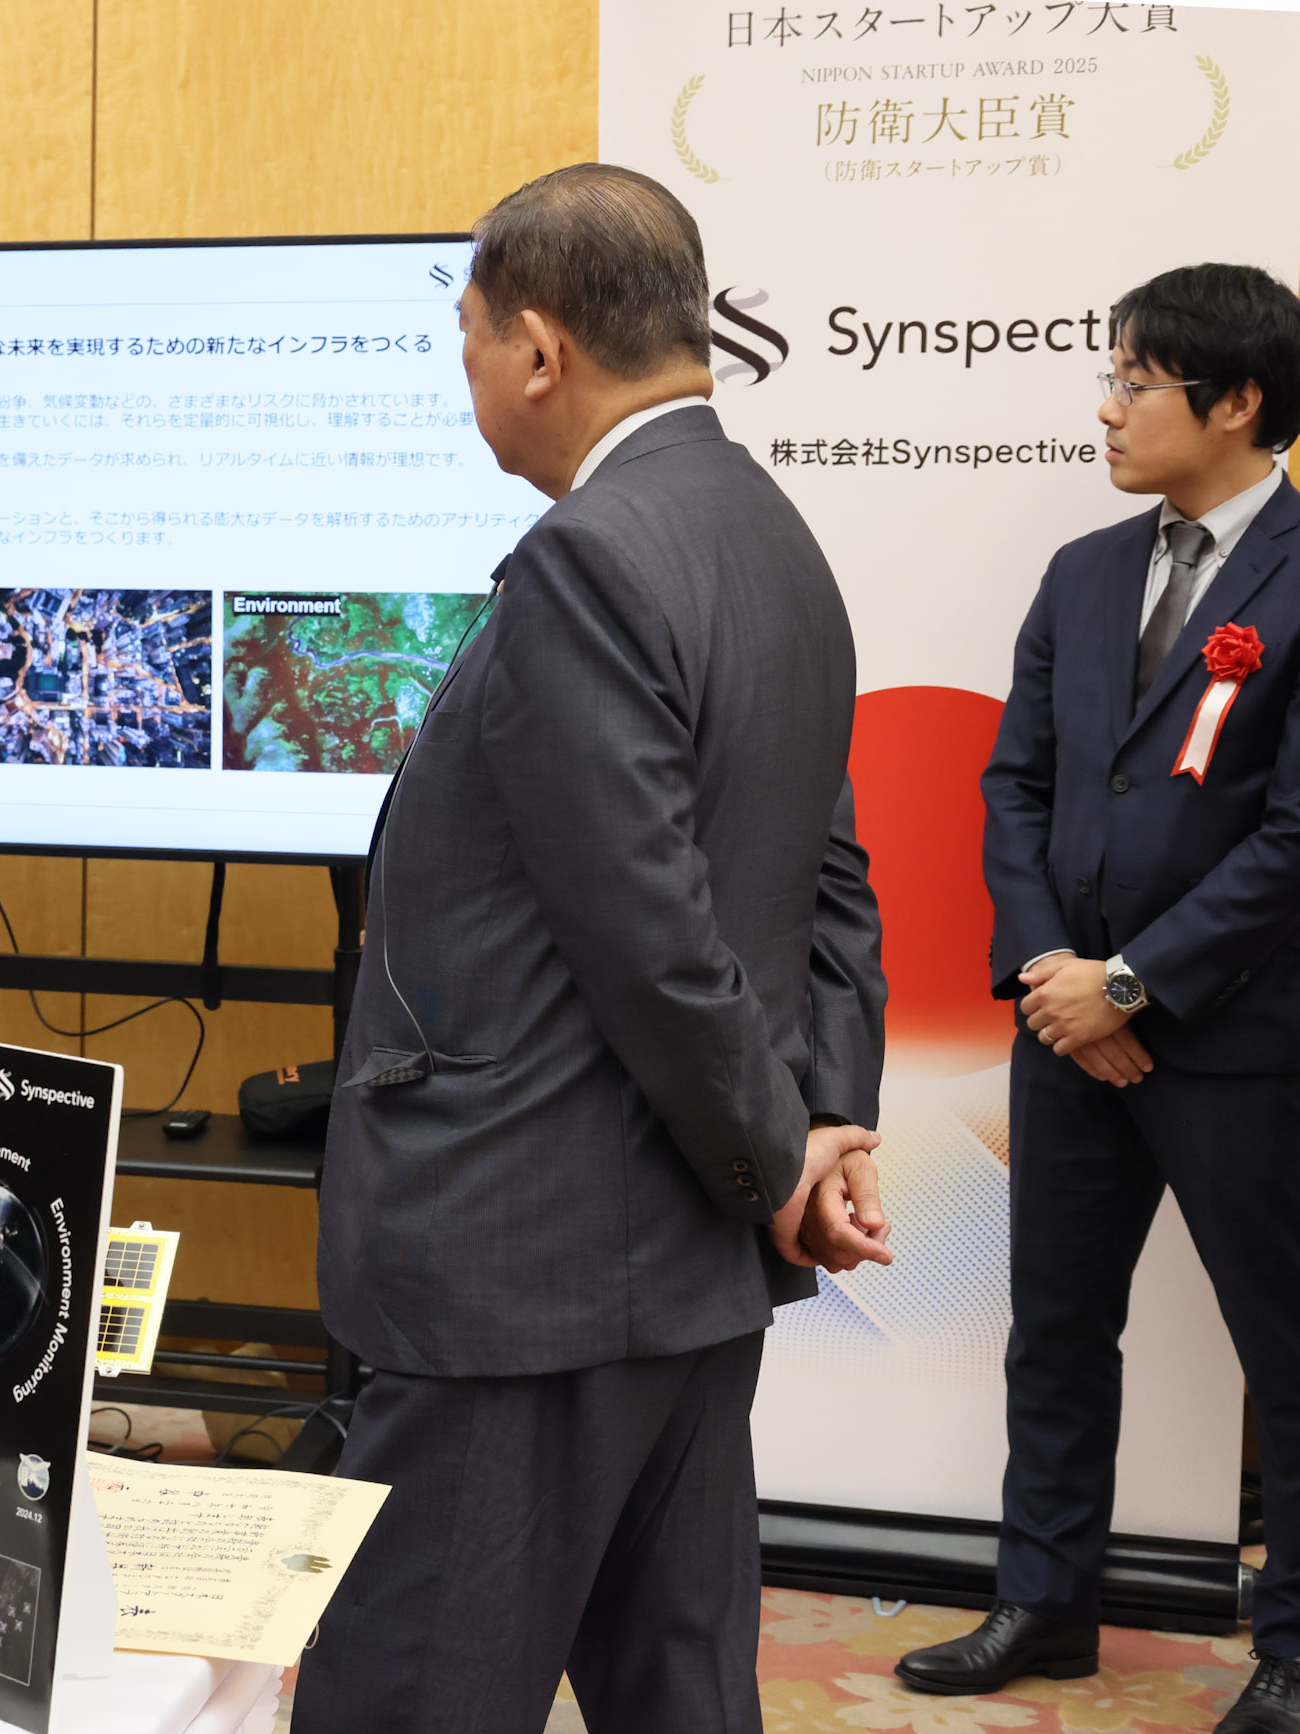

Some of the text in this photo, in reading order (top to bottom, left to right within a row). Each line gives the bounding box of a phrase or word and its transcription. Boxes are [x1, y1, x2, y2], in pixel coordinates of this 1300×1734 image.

[801, 56, 1098, 84] NIPPON STARTUP AWARD 2025
[816, 93, 1075, 146] 防衛大臣賞
[824, 153, 1062, 181] （防衛スタートアップ賞）
[771, 437, 1096, 469] 株式会社Synspective
[233, 596, 341, 614] Environment
[20, 1079, 95, 1109] Synspective
[12, 1197, 73, 1403] Environment Monitoring
[16, 1507, 43, 1523] 2024.12
